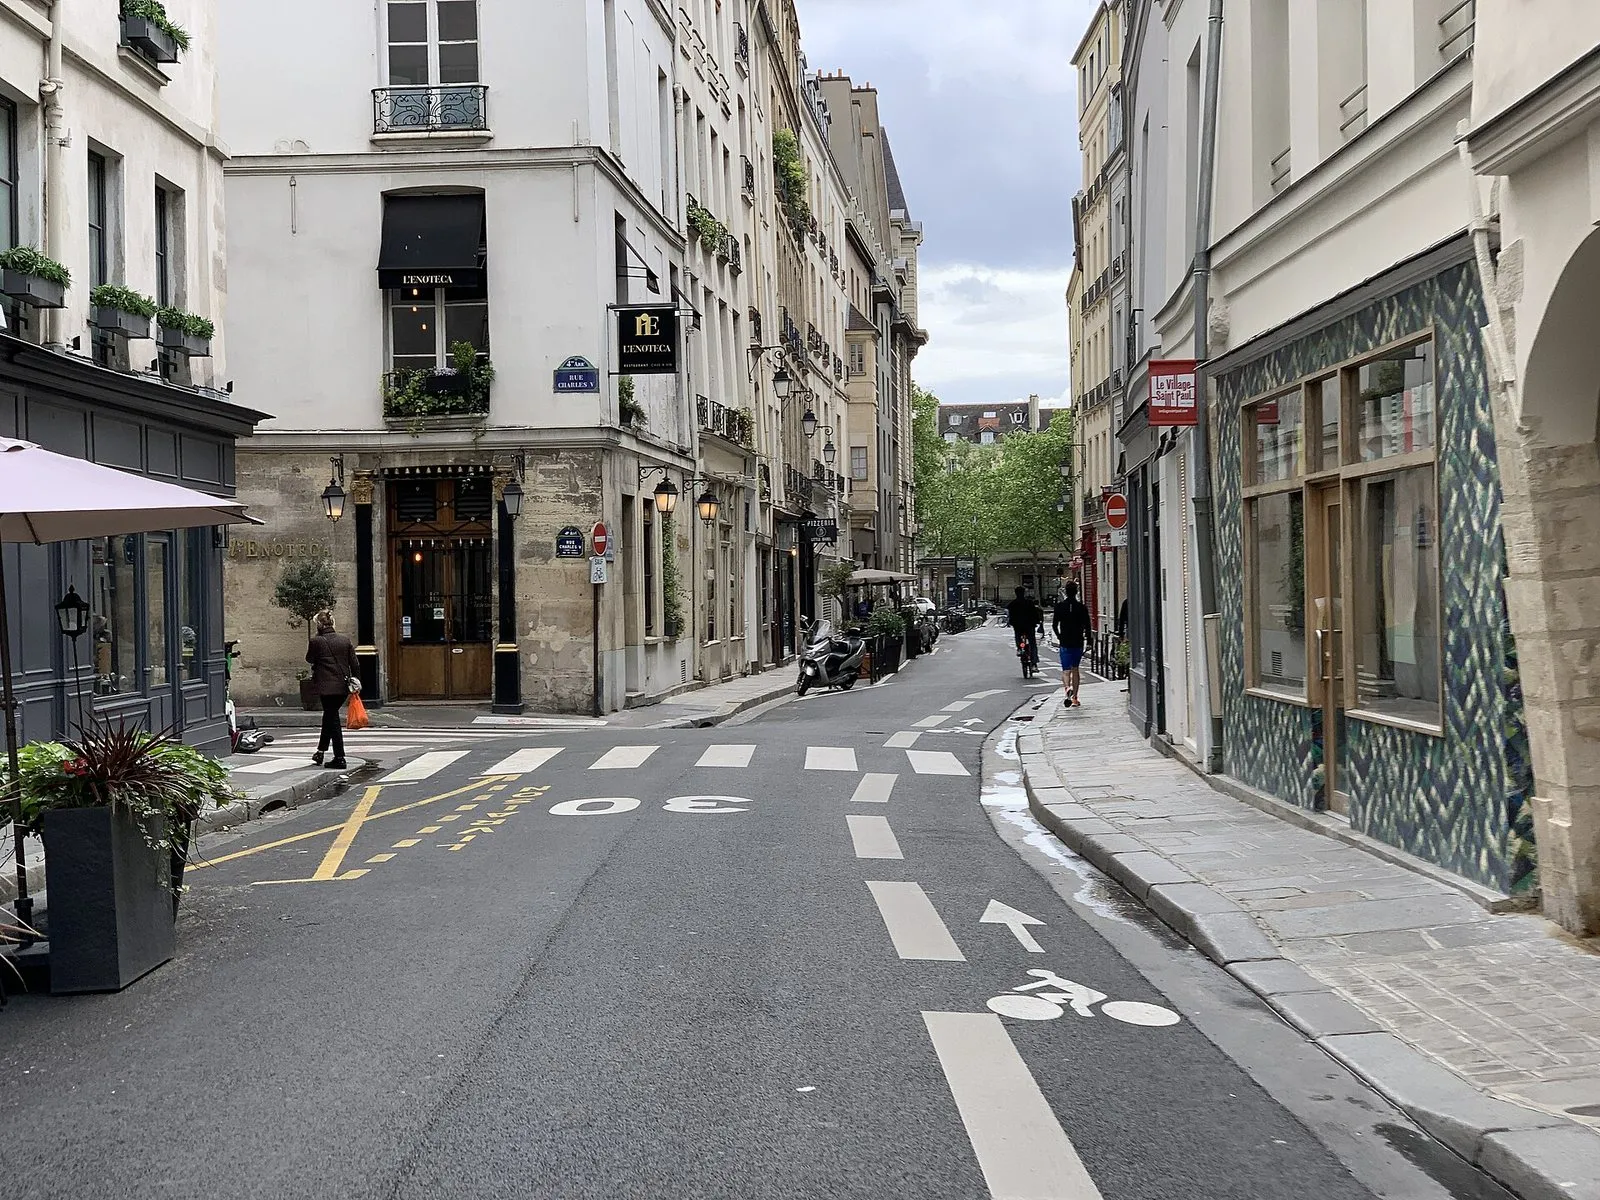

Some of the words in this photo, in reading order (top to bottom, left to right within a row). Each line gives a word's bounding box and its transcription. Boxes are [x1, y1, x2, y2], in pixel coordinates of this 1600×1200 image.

[403, 275, 453, 284] L'ENOTECA
[623, 344, 671, 353] L'ENOTECA
[1166, 376, 1191, 391] Village
[806, 519, 835, 527] PIZZERIA
